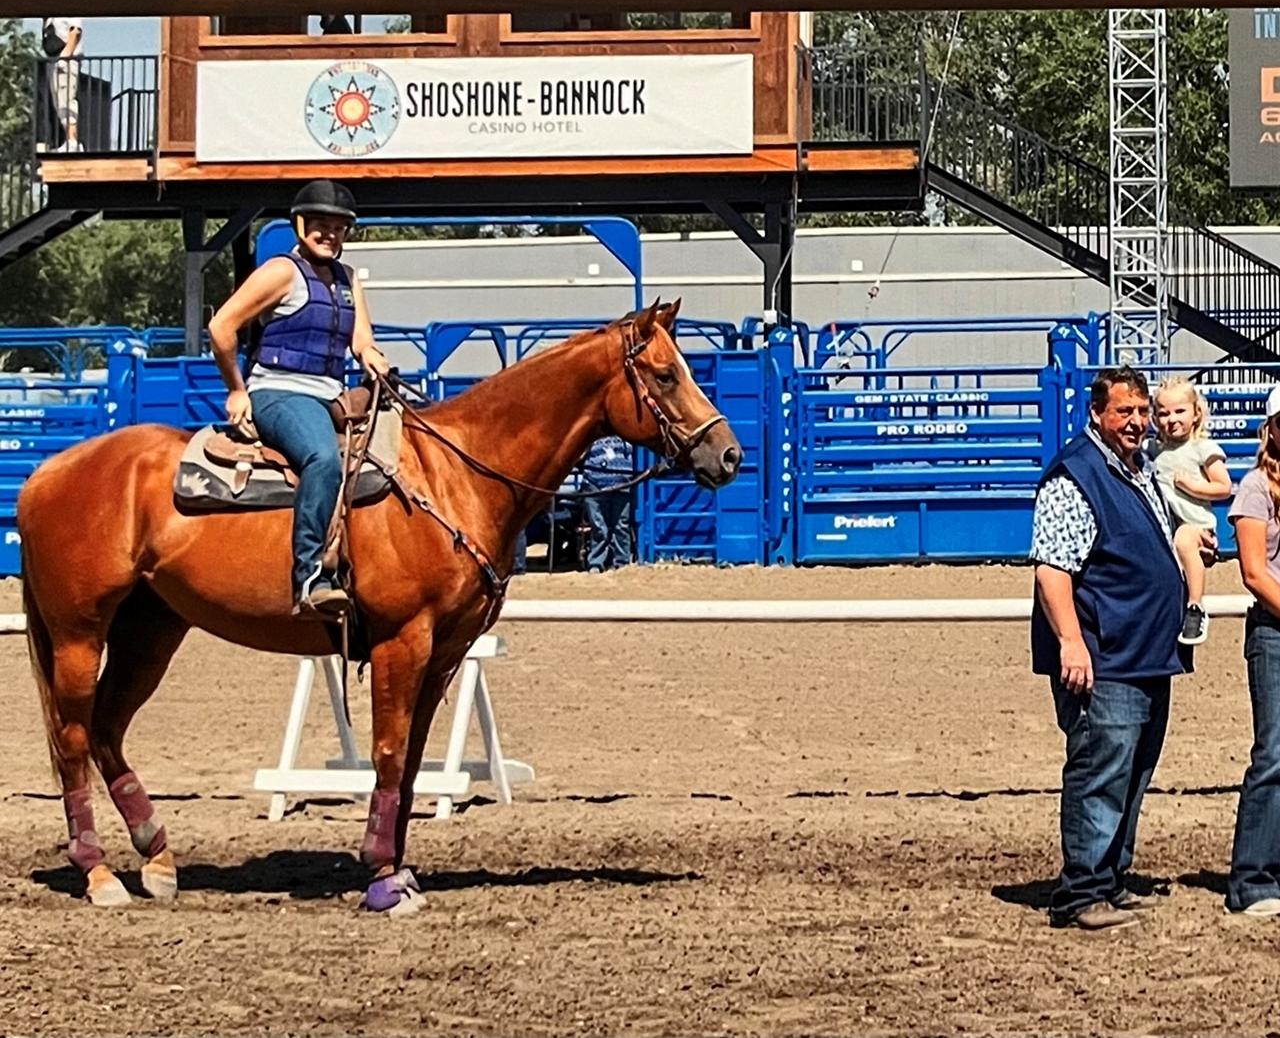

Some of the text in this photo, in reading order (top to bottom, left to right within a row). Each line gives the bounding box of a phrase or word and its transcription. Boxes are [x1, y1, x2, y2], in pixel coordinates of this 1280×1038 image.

[467, 120, 583, 135] CASINO HOTEL
[876, 423, 968, 436] PRO RODEO
[1203, 418, 1247, 430] ODEO
